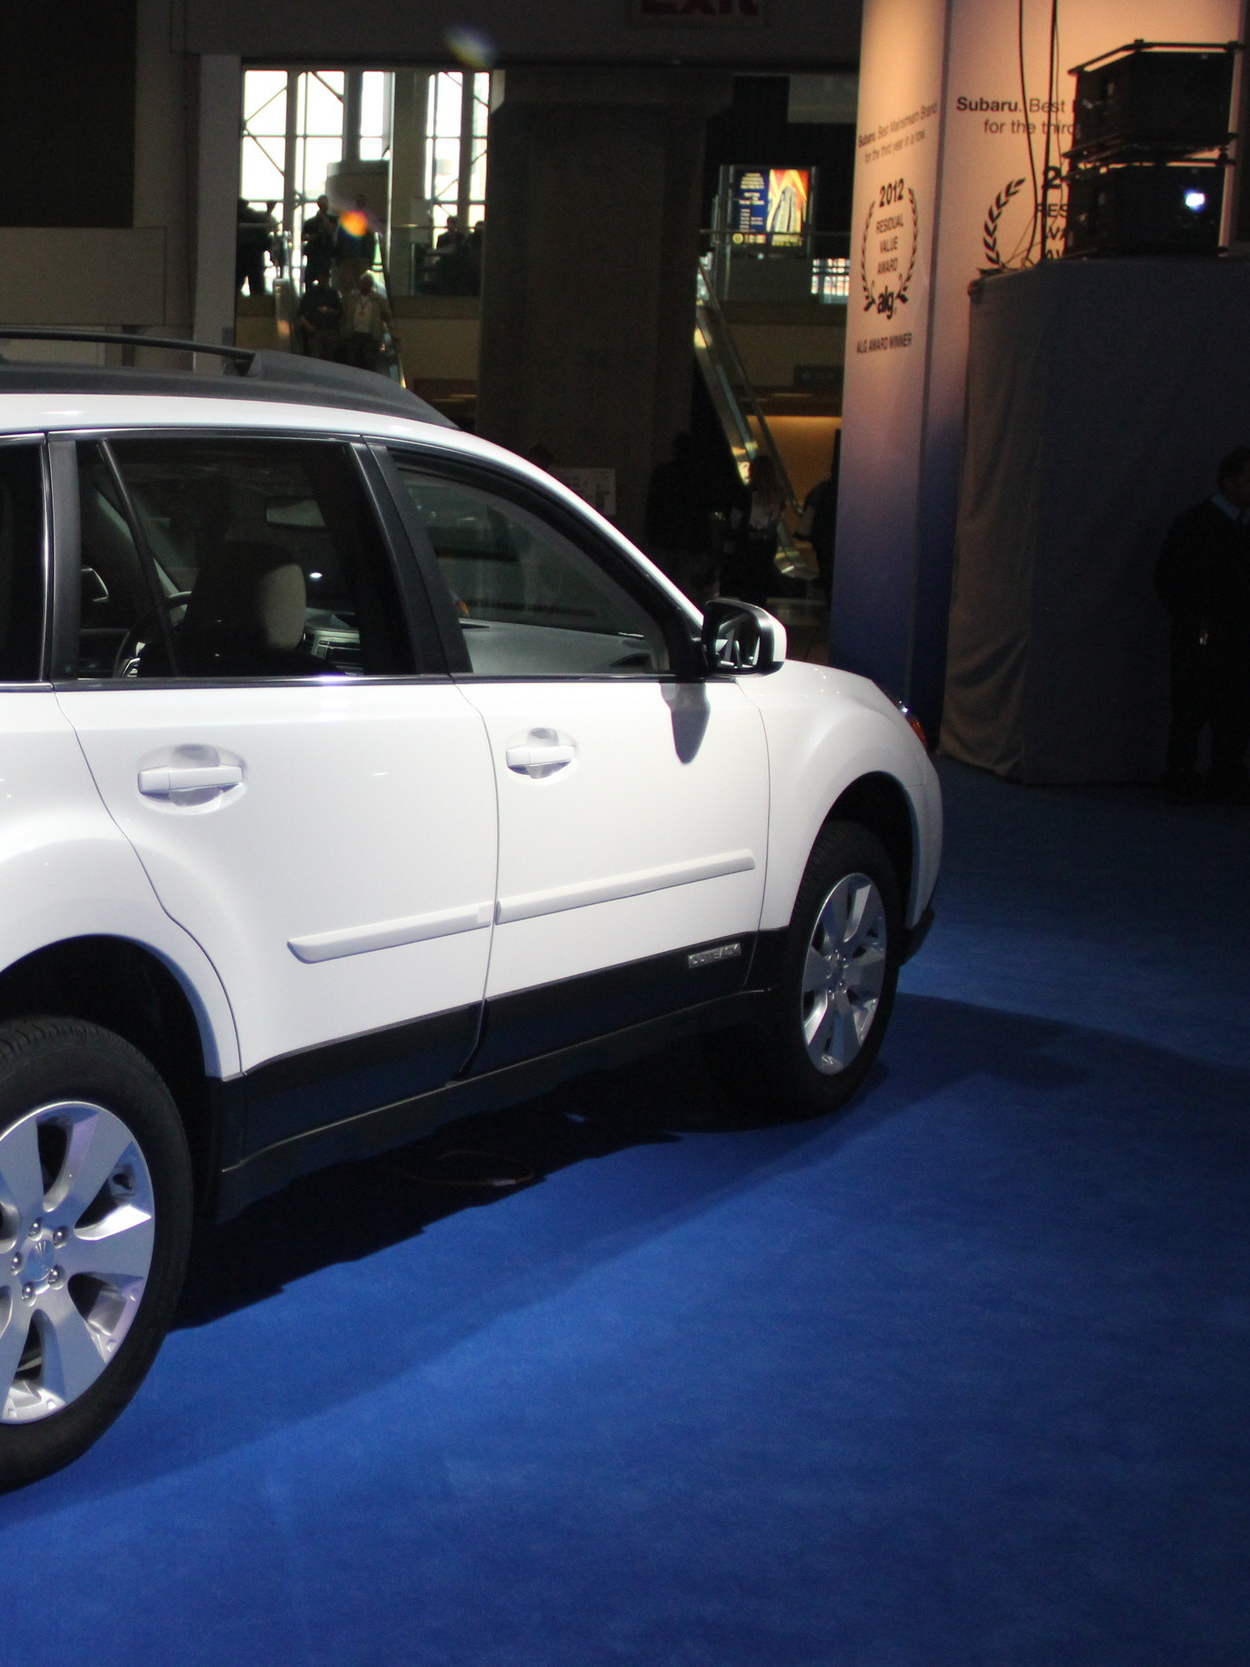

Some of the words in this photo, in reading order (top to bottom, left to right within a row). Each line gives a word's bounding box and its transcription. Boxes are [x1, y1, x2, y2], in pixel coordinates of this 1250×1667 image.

[956, 96, 1023, 113] Subaru.
[983, 118, 1006, 134] for
[1011, 119, 1036, 135] the
[879, 178, 904, 209] 2012
[877, 214, 904, 235] RESIDUAL
[880, 237, 898, 254] VALUE
[878, 258, 898, 275] AWARD
[878, 286, 895, 320] alg
[869, 337, 889, 352] AWARD
[890, 333, 912, 350] WINNER
